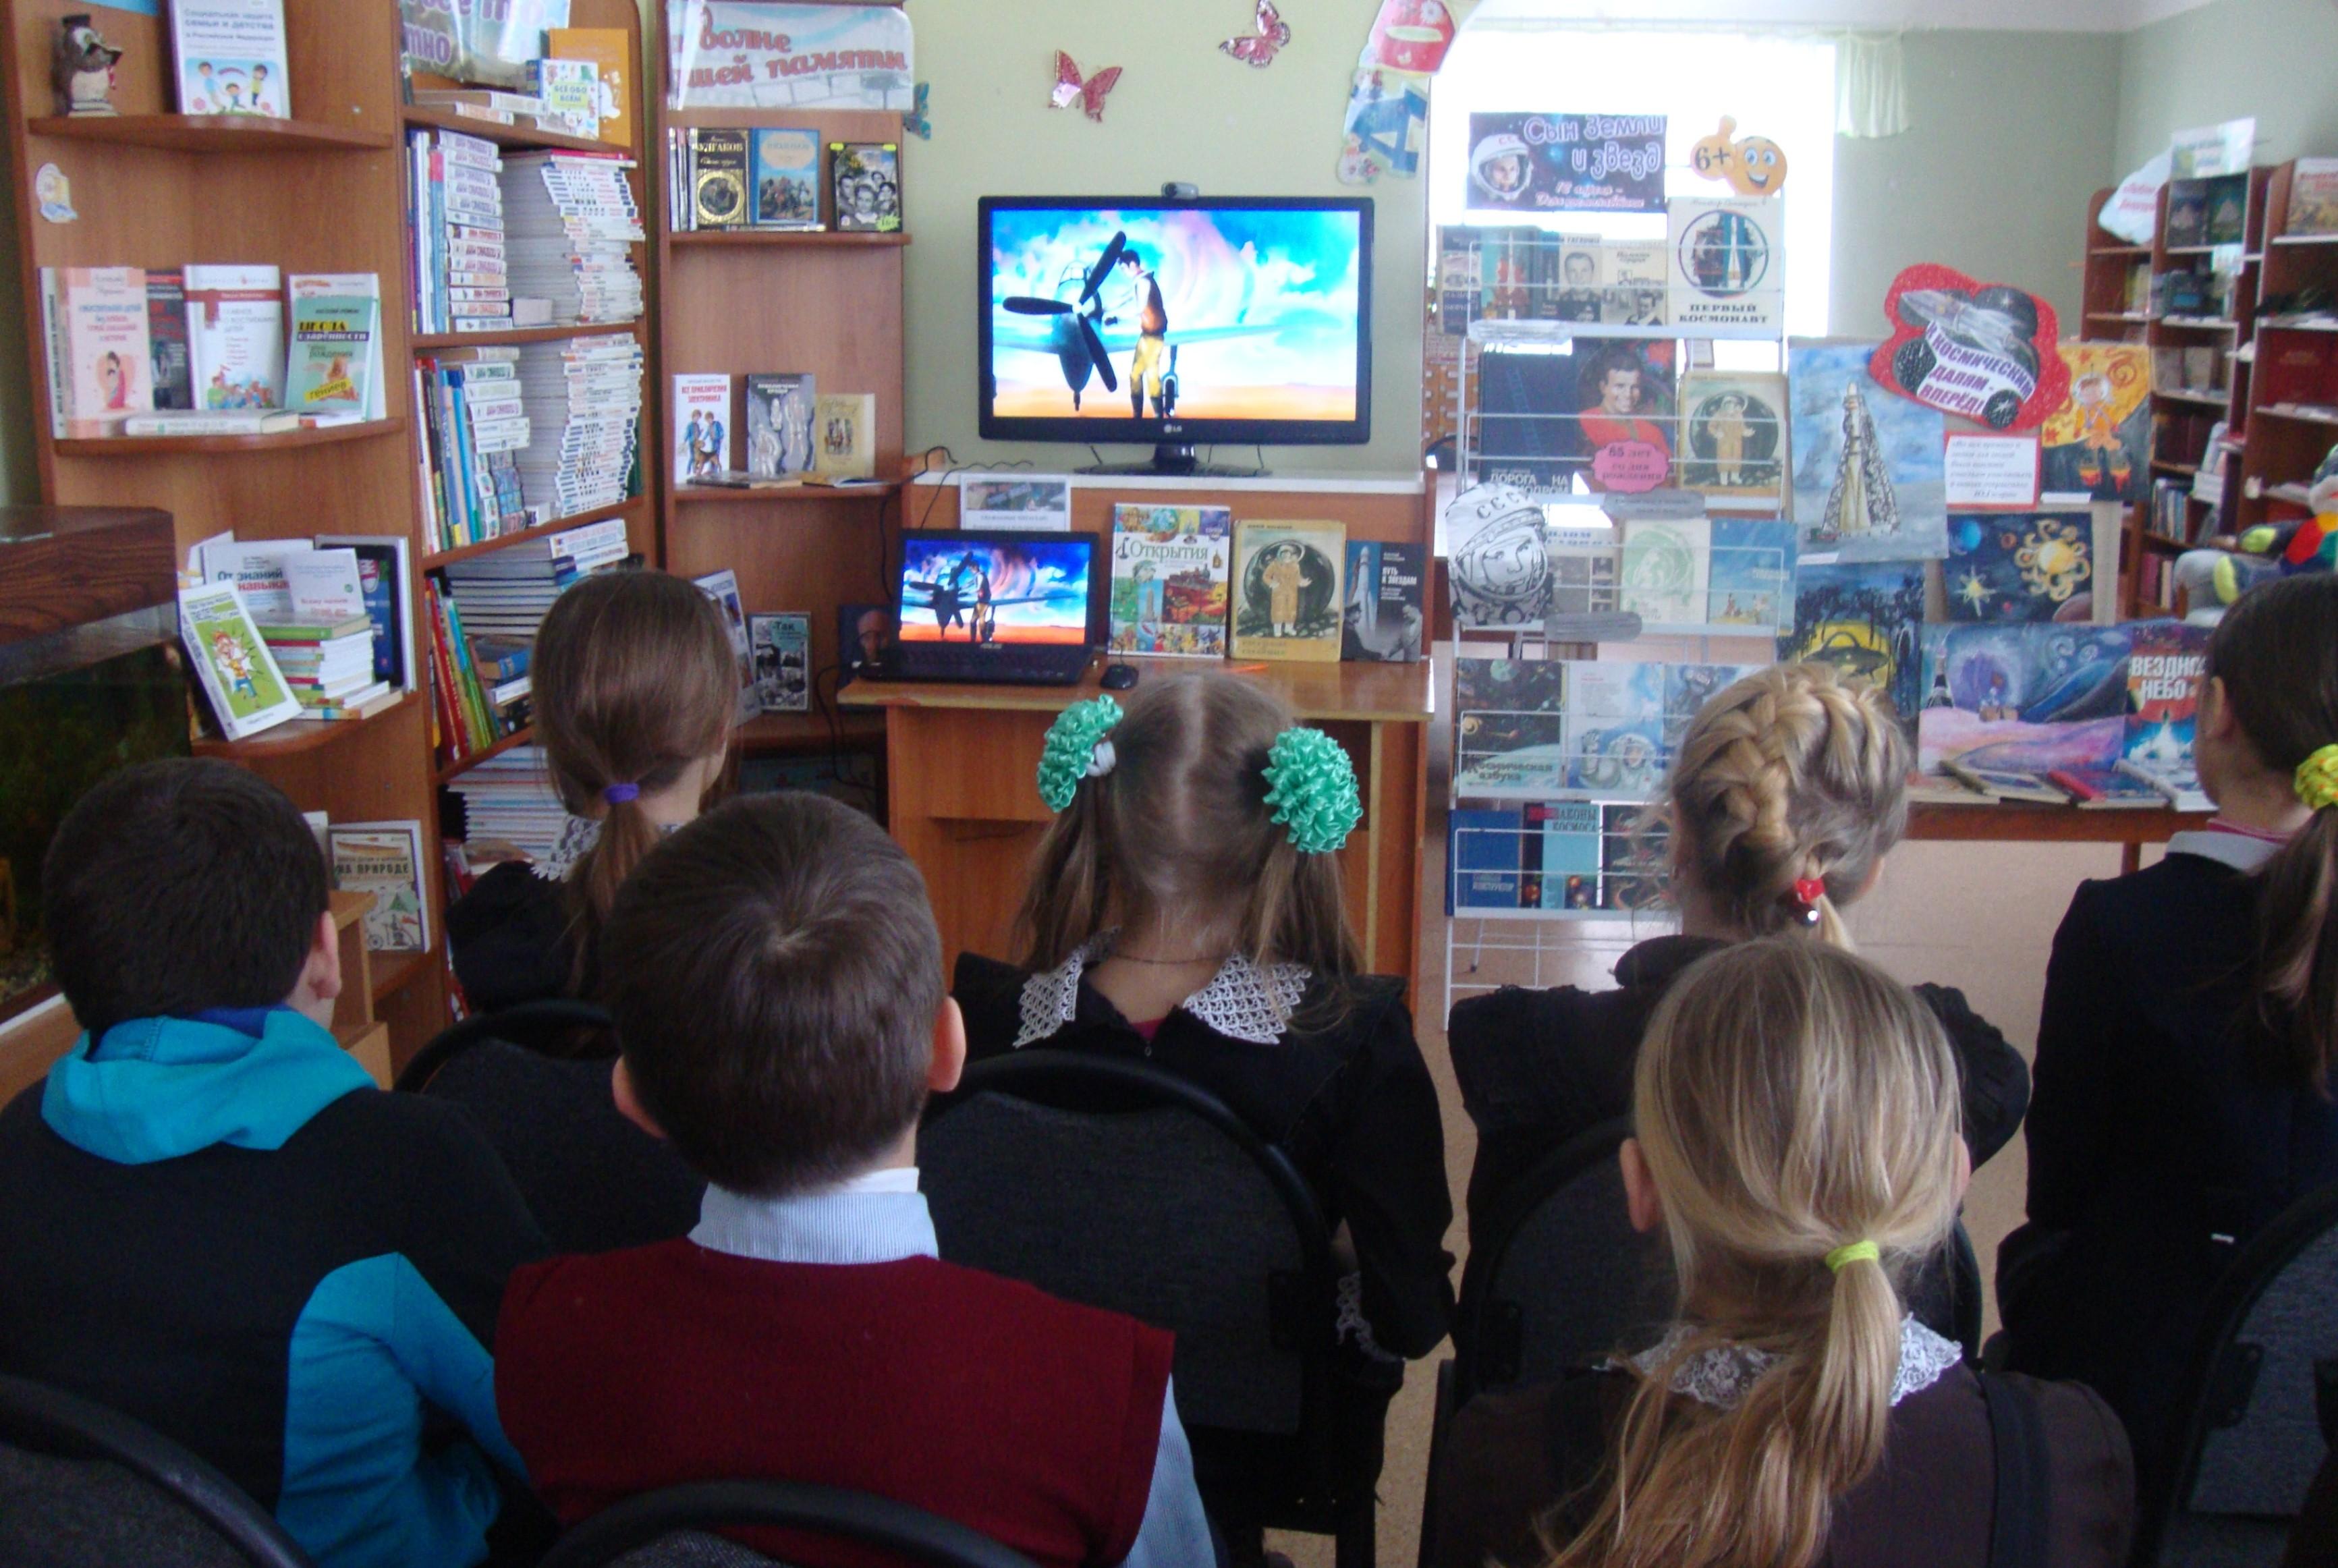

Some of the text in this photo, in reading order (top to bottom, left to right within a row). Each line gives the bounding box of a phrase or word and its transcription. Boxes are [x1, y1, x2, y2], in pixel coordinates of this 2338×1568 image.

[688, 50, 908, 88] шей памяти
[1524, 117, 1579, 144] Сын
[1694, 146, 1731, 171] 6+
[1678, 315, 1768, 323] КОСМОНАВТ
[1689, 303, 1757, 312] ПЕРВЫЙ
[1928, 364, 1990, 391] ДАЛЯМ
[1932, 333, 2034, 401] КОСМИЧЕСКИМ
[1918, 383, 1986, 414] ВПЕРЁД!
[1490, 474, 1569, 486] ДОРОГА НА
[1130, 540, 1208, 563] Открытия
[2129, 655, 2206, 677] ВЕЗДНО
[2142, 679, 2187, 699] НЕБО
[1559, 809, 1596, 820] АКОНЫ
